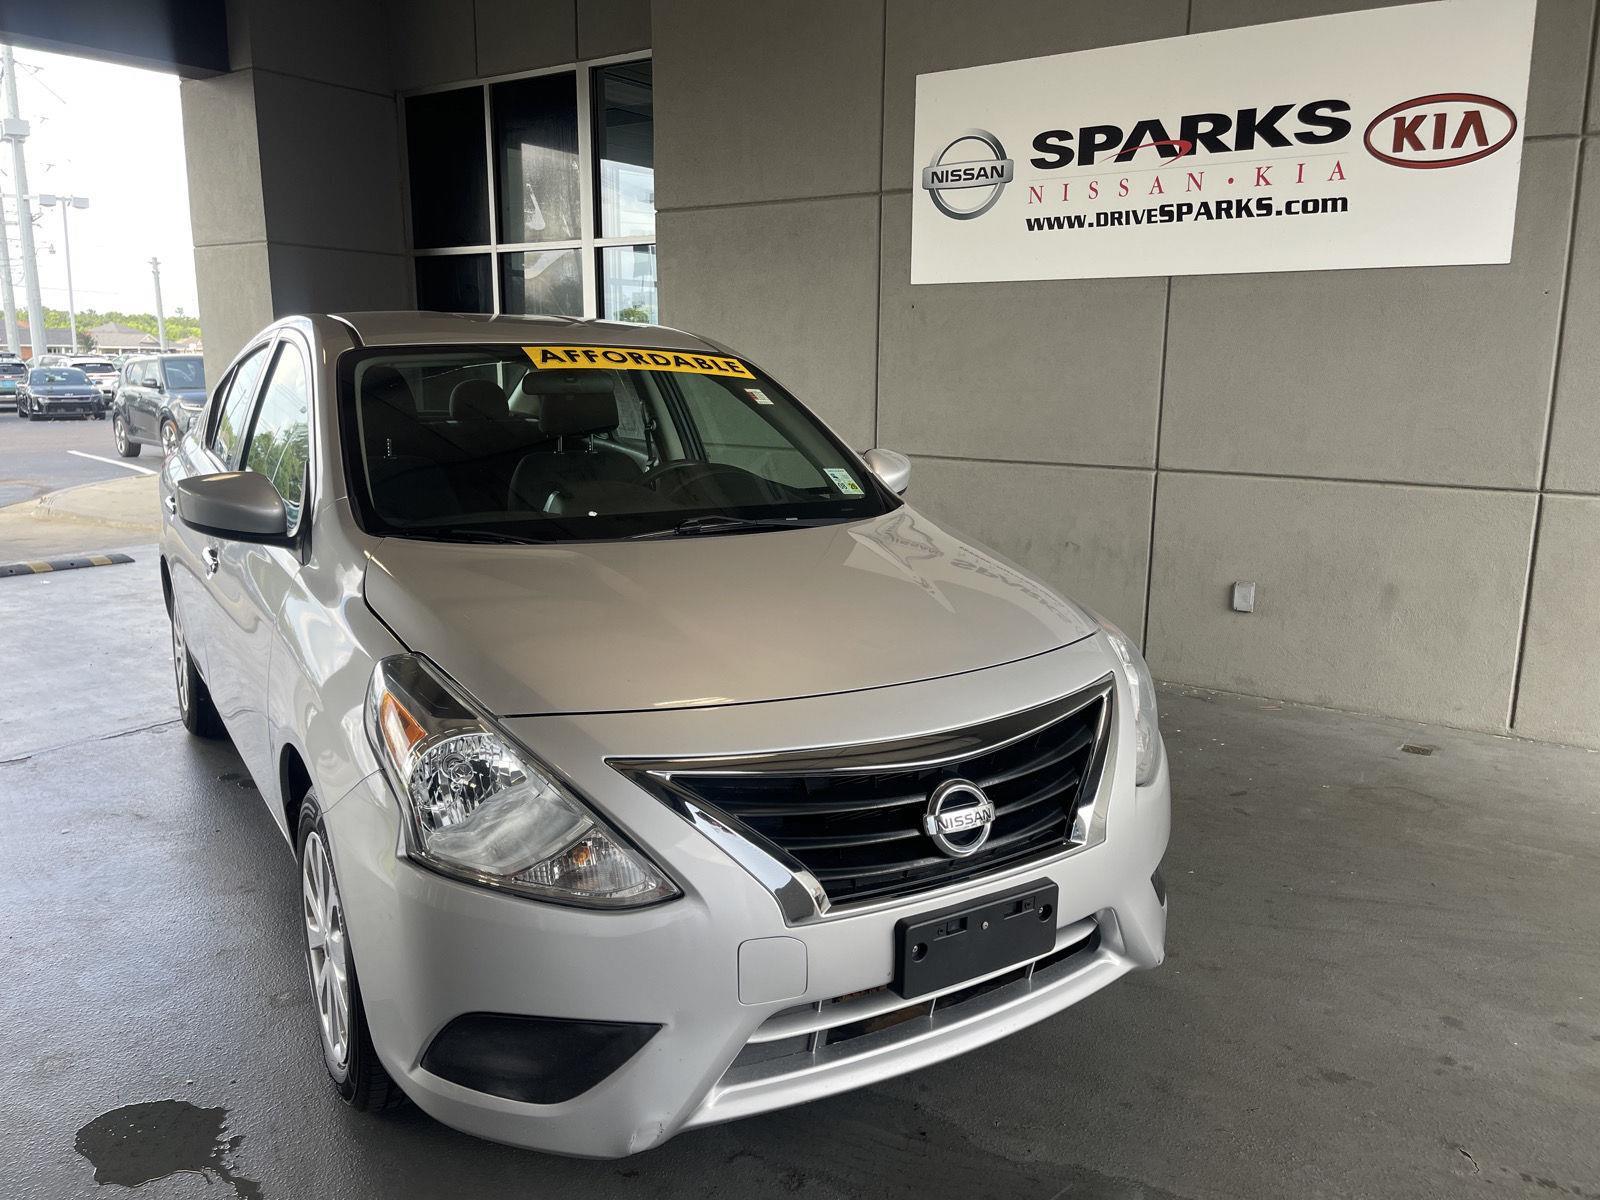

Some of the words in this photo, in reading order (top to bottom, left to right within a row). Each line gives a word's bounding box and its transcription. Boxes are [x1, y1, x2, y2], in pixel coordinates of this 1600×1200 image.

[1030, 99, 1352, 170] SPARKS
[1391, 109, 1490, 154] KIA
[931, 165, 1005, 184] NISSAN
[1028, 172, 1205, 205] NISSAN
[1253, 159, 1347, 188] KIA
[1025, 196, 1349, 232] www.DRIVESPARKS.com
[541, 349, 746, 374] AFFORDABLE
[937, 807, 992, 830] NISSAN
